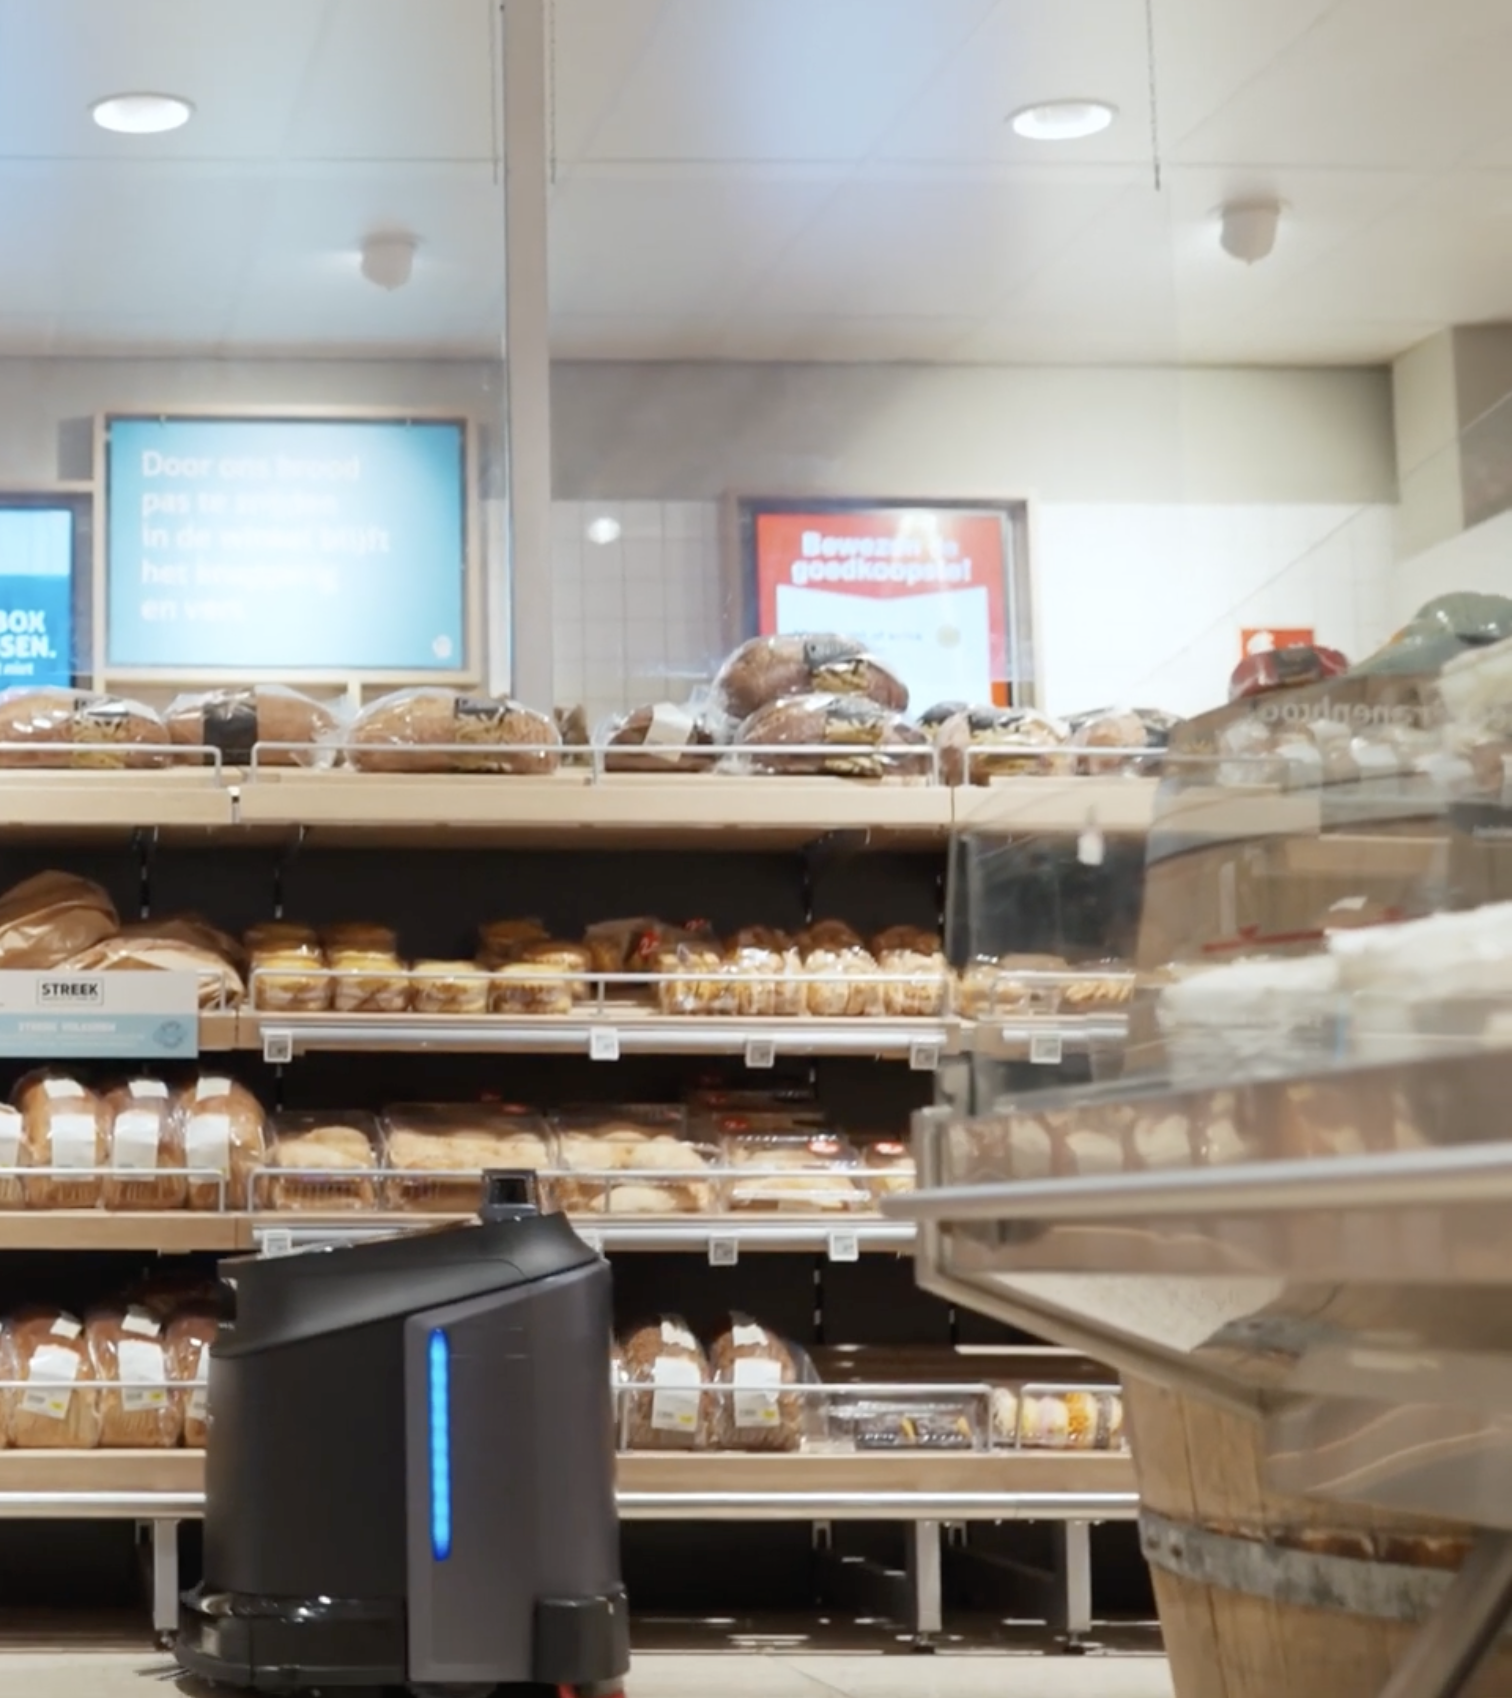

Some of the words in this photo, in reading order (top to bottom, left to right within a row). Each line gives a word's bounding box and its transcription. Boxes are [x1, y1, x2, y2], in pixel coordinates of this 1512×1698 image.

[141, 450, 212, 478] Door
[142, 521, 169, 548] in
[41, 983, 99, 996] STREEK
